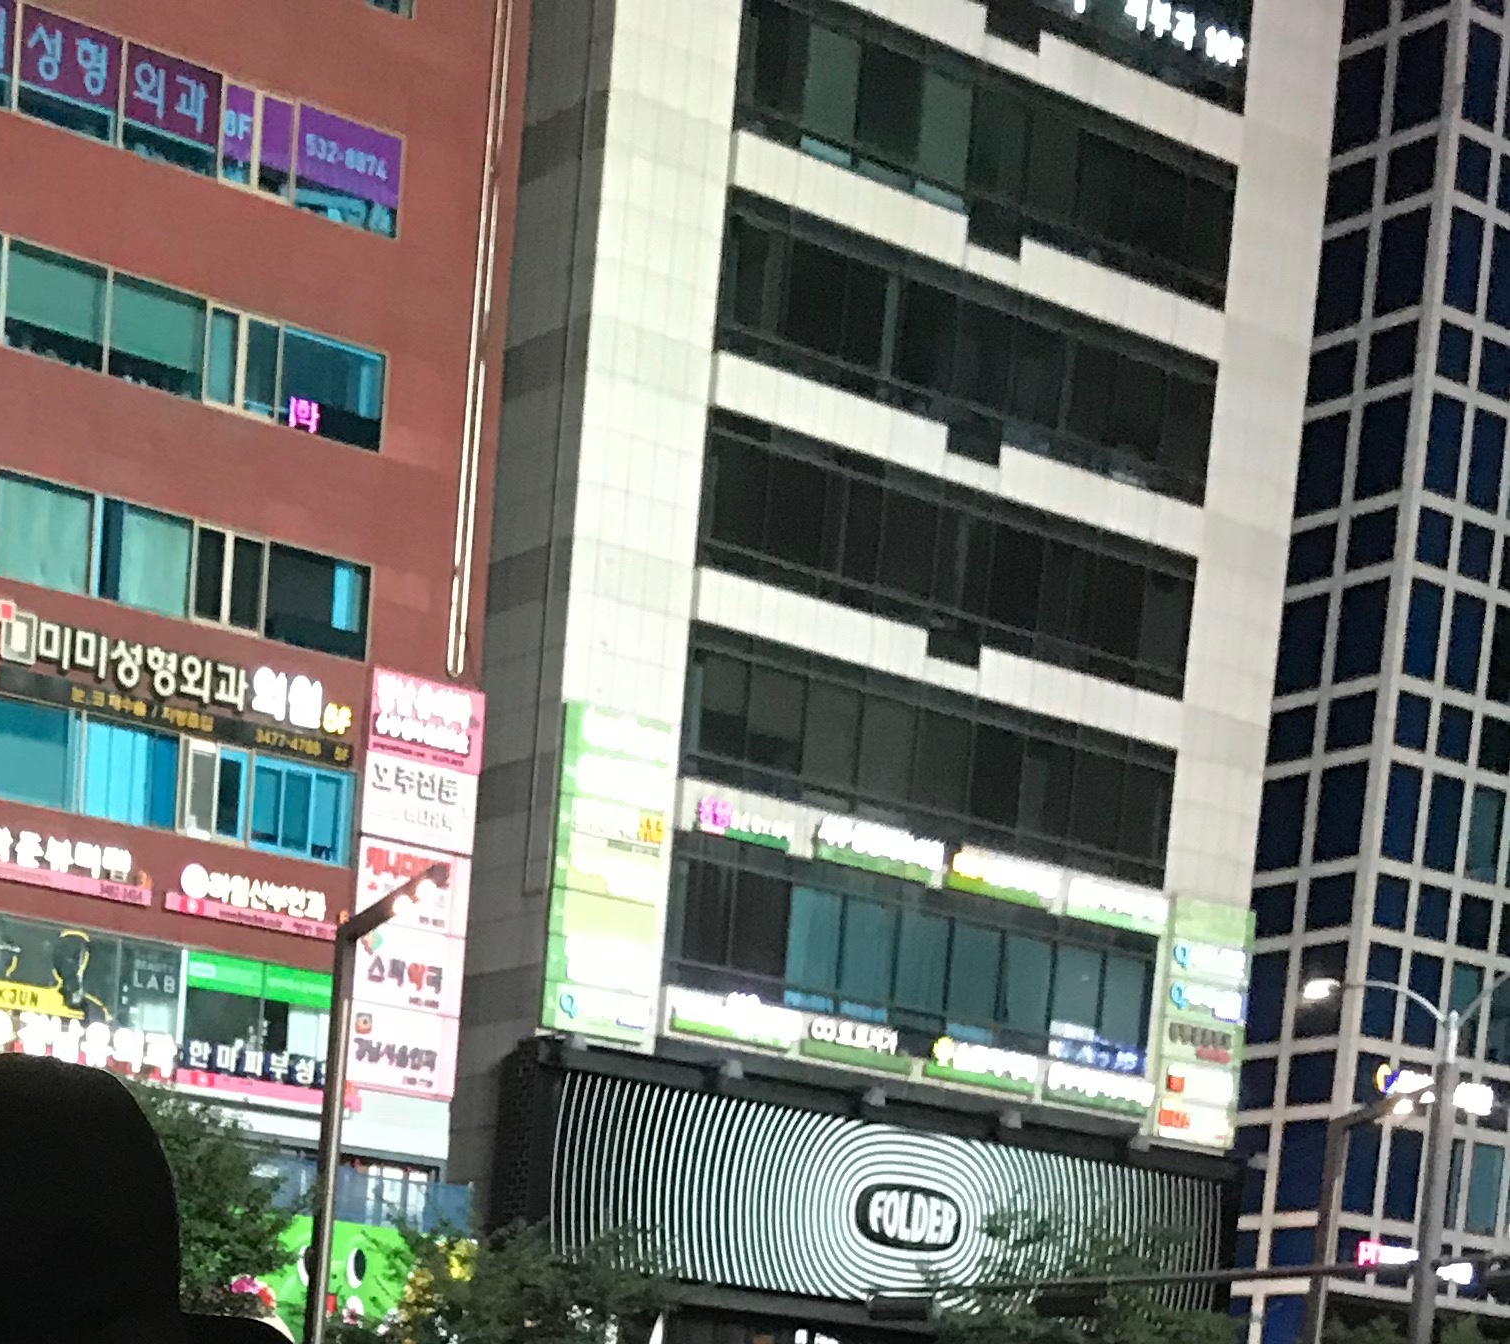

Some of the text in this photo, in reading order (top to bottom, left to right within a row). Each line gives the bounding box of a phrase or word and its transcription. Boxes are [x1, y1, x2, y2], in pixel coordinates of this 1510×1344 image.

[39, 620, 248, 712] 미미성형외과
[132, 971, 176, 994] LAB
[870, 1189, 957, 1245] FOLDER
